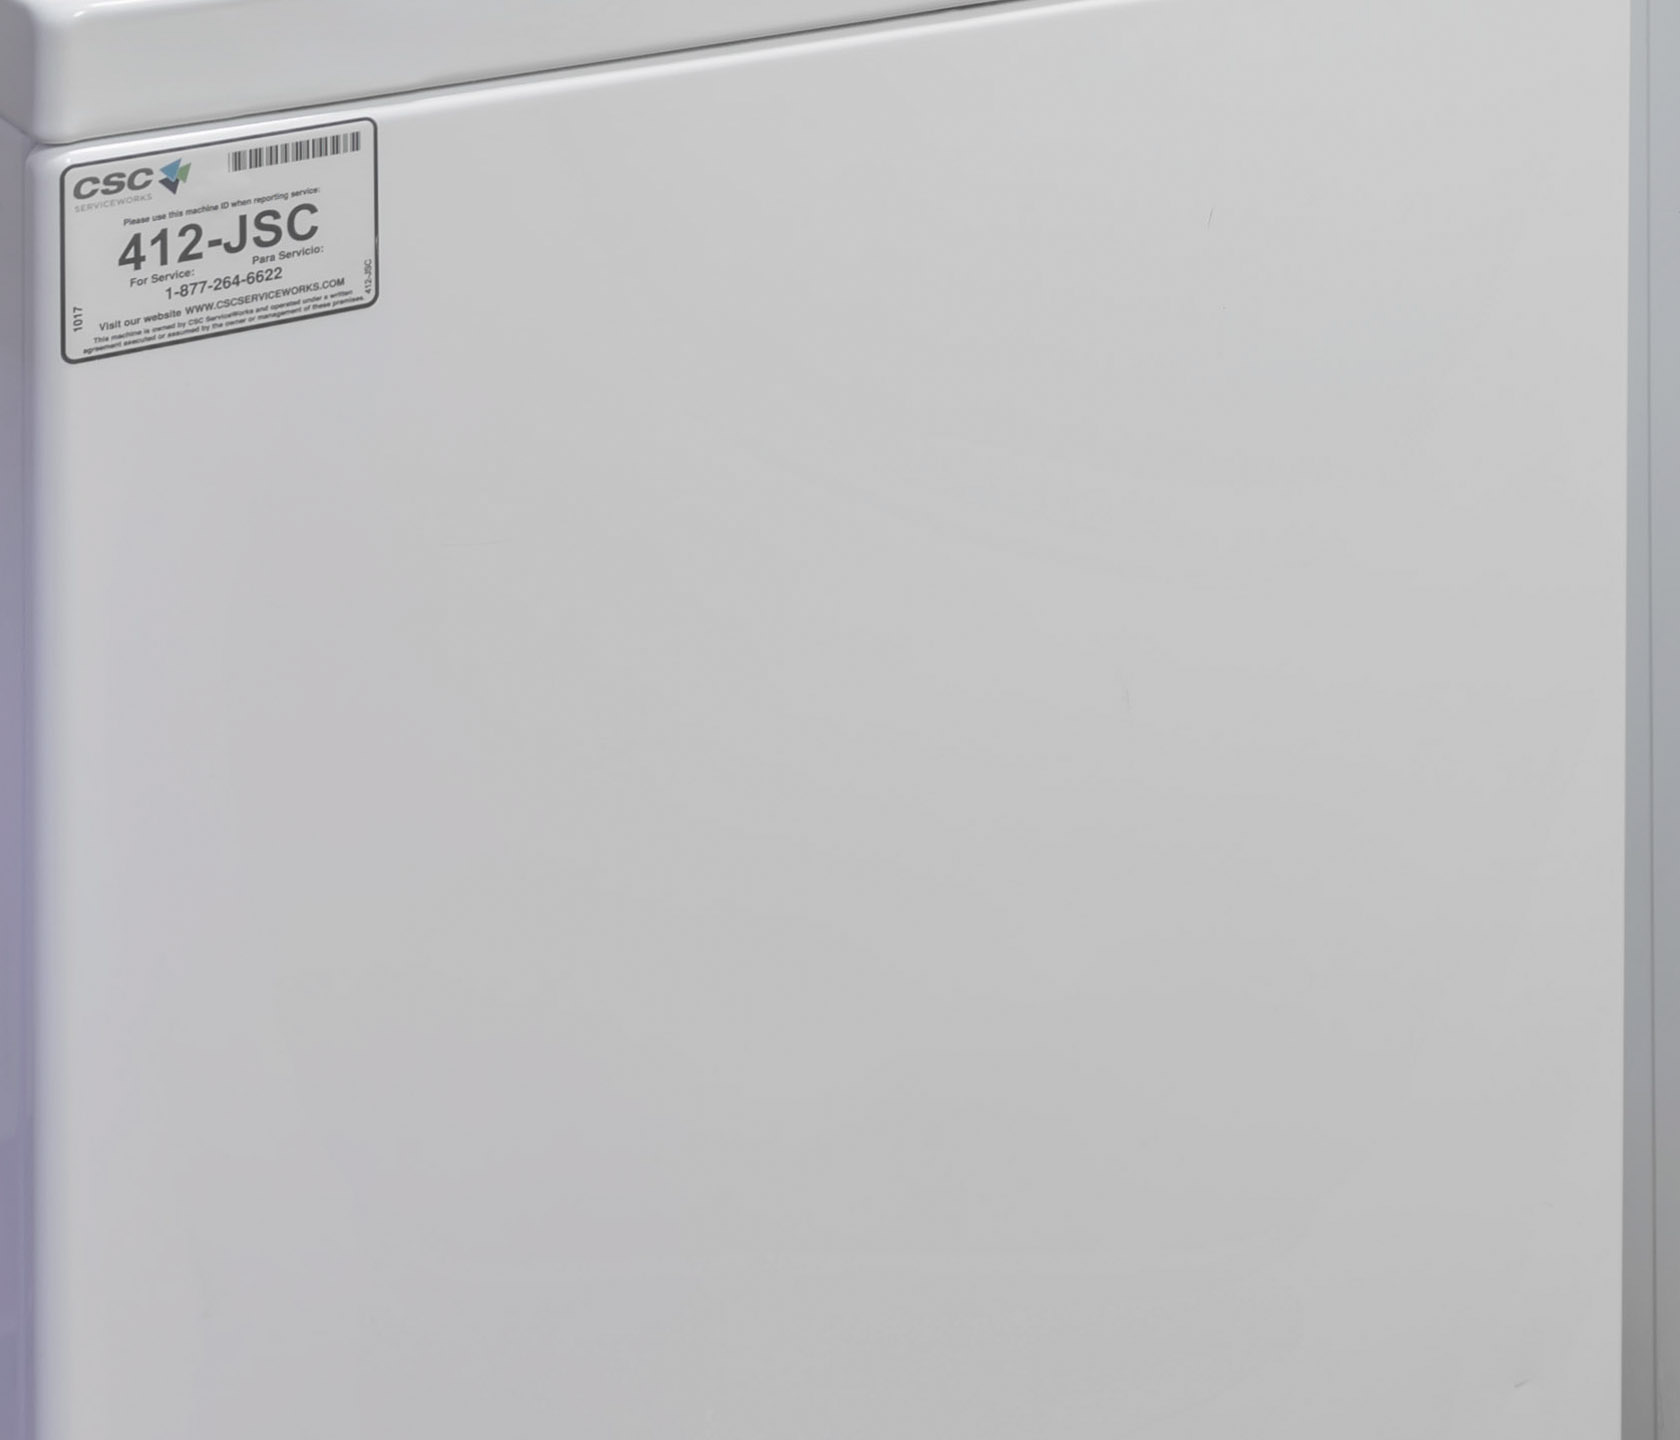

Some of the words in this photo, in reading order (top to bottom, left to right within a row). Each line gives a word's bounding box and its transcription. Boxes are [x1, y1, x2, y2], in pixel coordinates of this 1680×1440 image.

[73, 168, 154, 200] CSC
[74, 193, 152, 213] SERVICEWORKS
[123, 215, 150, 226] Please
[152, 213, 166, 221] use
[169, 210, 183, 219] this
[185, 204, 219, 216] machine
[221, 202, 230, 210] ID
[231, 198, 252, 208] when
[253, 192, 289, 204] reporting
[290, 187, 321, 198] service:
[118, 203, 319, 271] 412-JSC
[252, 255, 276, 265] Para
[278, 245, 324, 261] Servicio:
[130, 277, 148, 288] For
[151, 269, 195, 284] Service:
[165, 266, 283, 300] 1-877-264-6622
[73, 306, 83, 332] 1017
[99, 320, 121, 331] Visit
[124, 317, 141, 327] our
[143, 310, 182, 323] website
[185, 277, 345, 315] WWW.CSCSERVICEWORKS.COM
